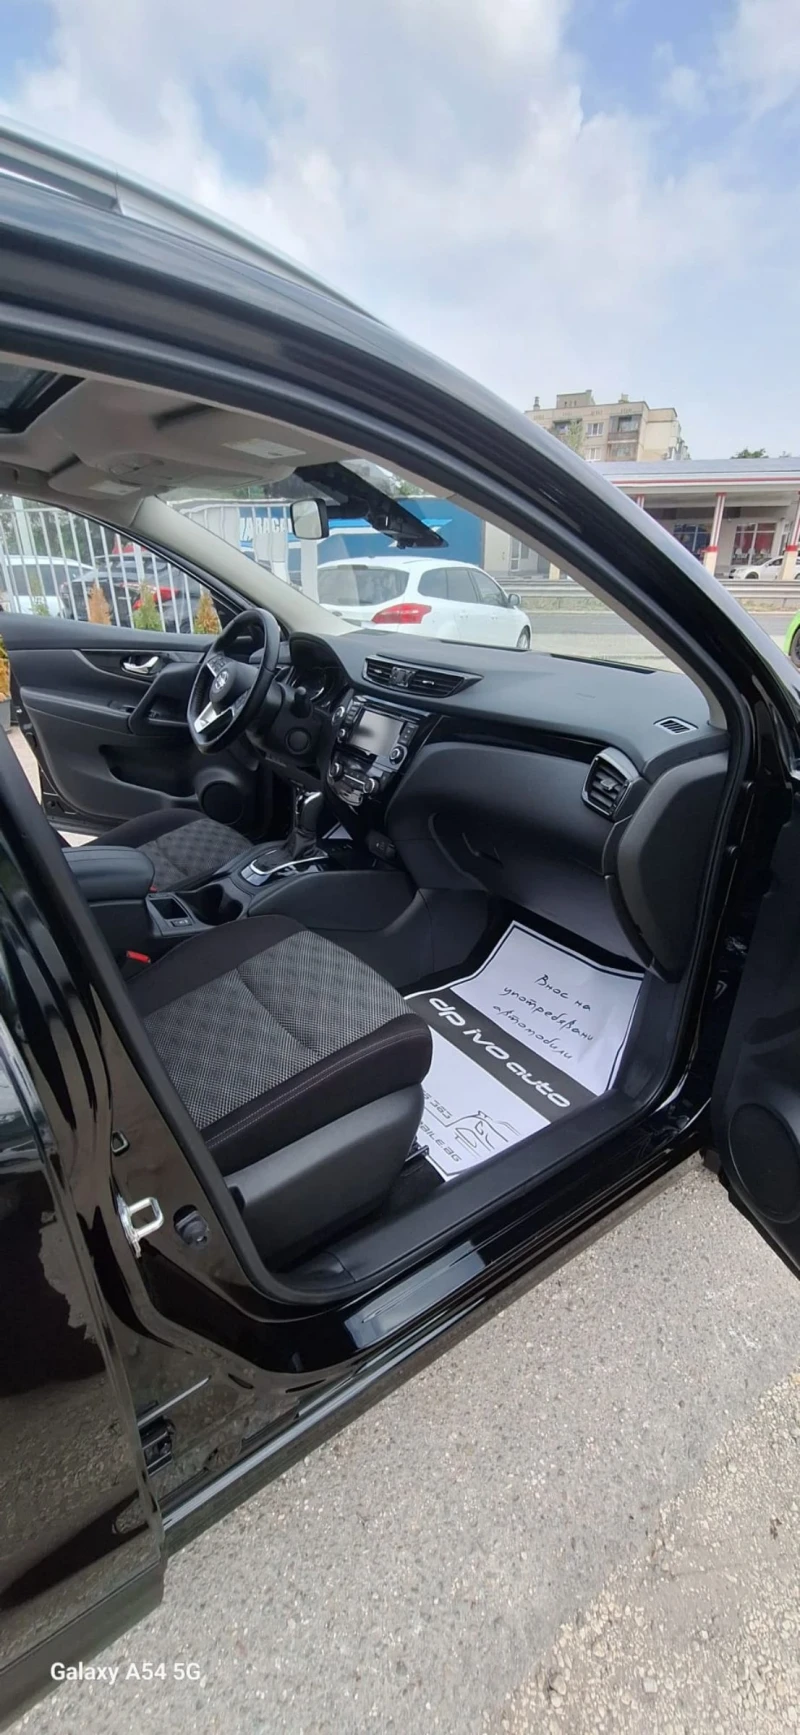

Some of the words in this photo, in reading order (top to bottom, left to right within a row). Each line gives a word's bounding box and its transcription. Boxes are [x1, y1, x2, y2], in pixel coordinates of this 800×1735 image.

[534, 974, 569, 999] Внос
[574, 1000, 591, 1012] на
[429, 997, 466, 1027] dp
[463, 1028, 510, 1060] ivo
[506, 1062, 571, 1108] auto
[493, 1005, 573, 1060] автомобили
